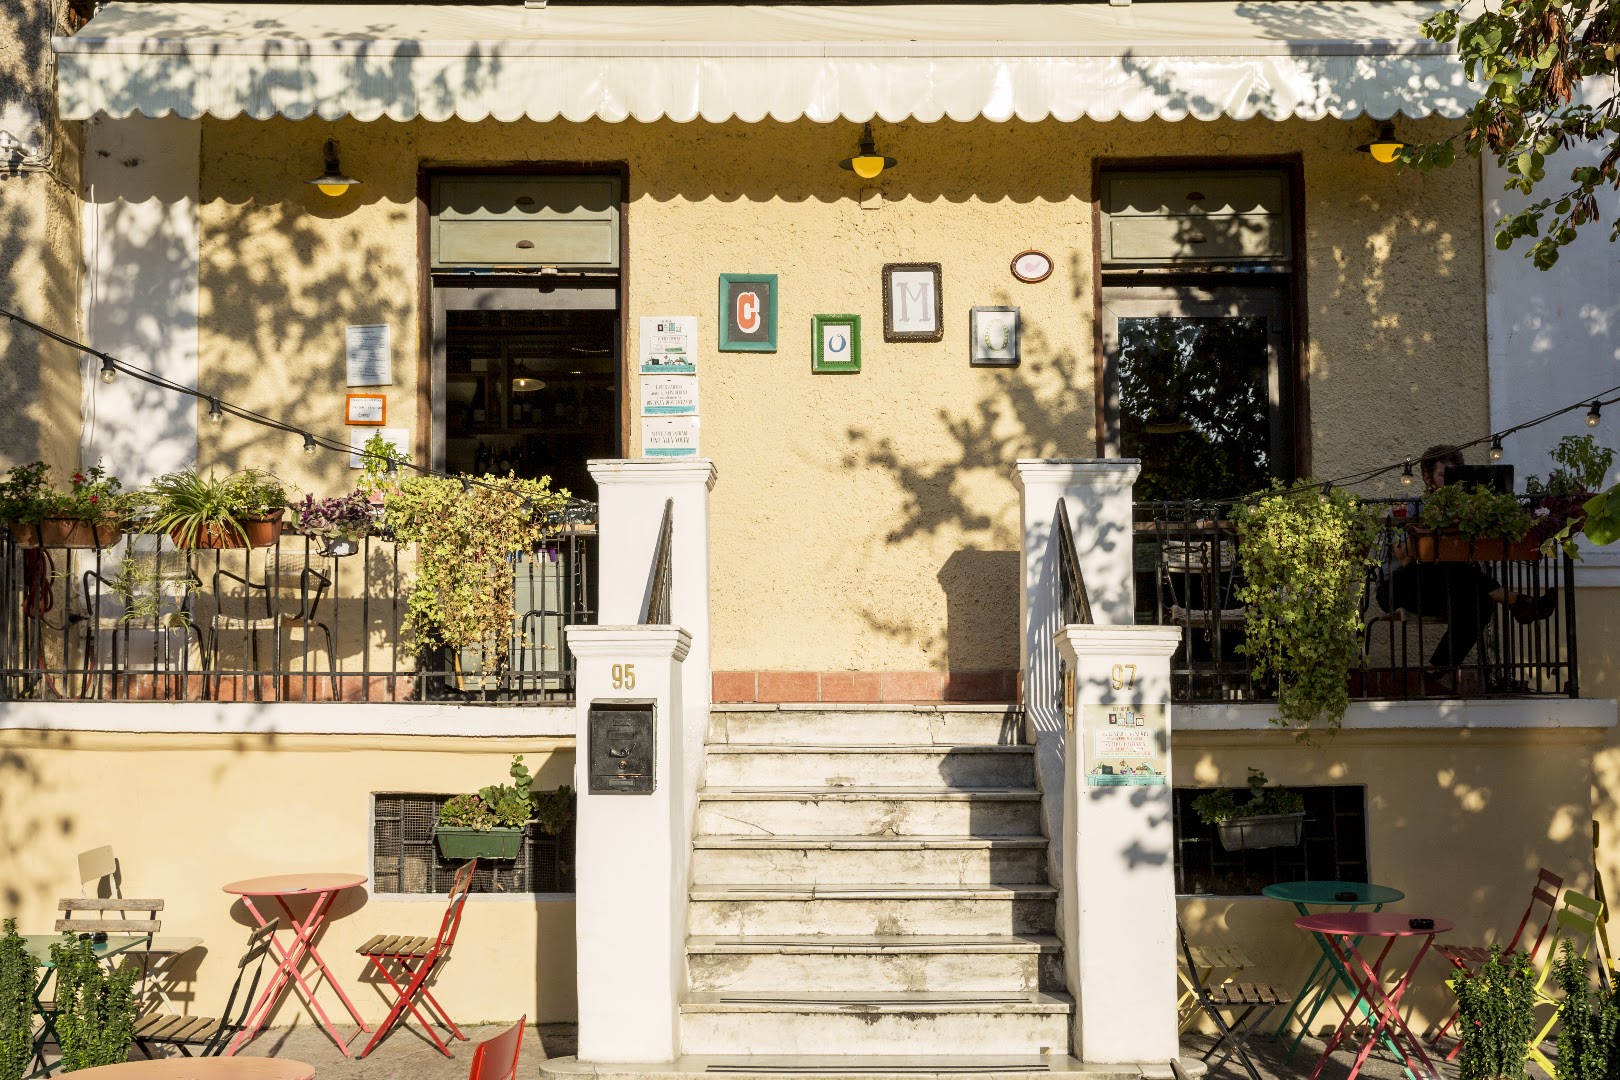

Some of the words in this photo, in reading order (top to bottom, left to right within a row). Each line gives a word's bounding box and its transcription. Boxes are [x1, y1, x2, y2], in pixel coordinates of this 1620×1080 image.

[737, 292, 761, 333] C
[896, 282, 931, 322] M
[612, 664, 635, 689] 95
[1112, 664, 1137, 690] 97
